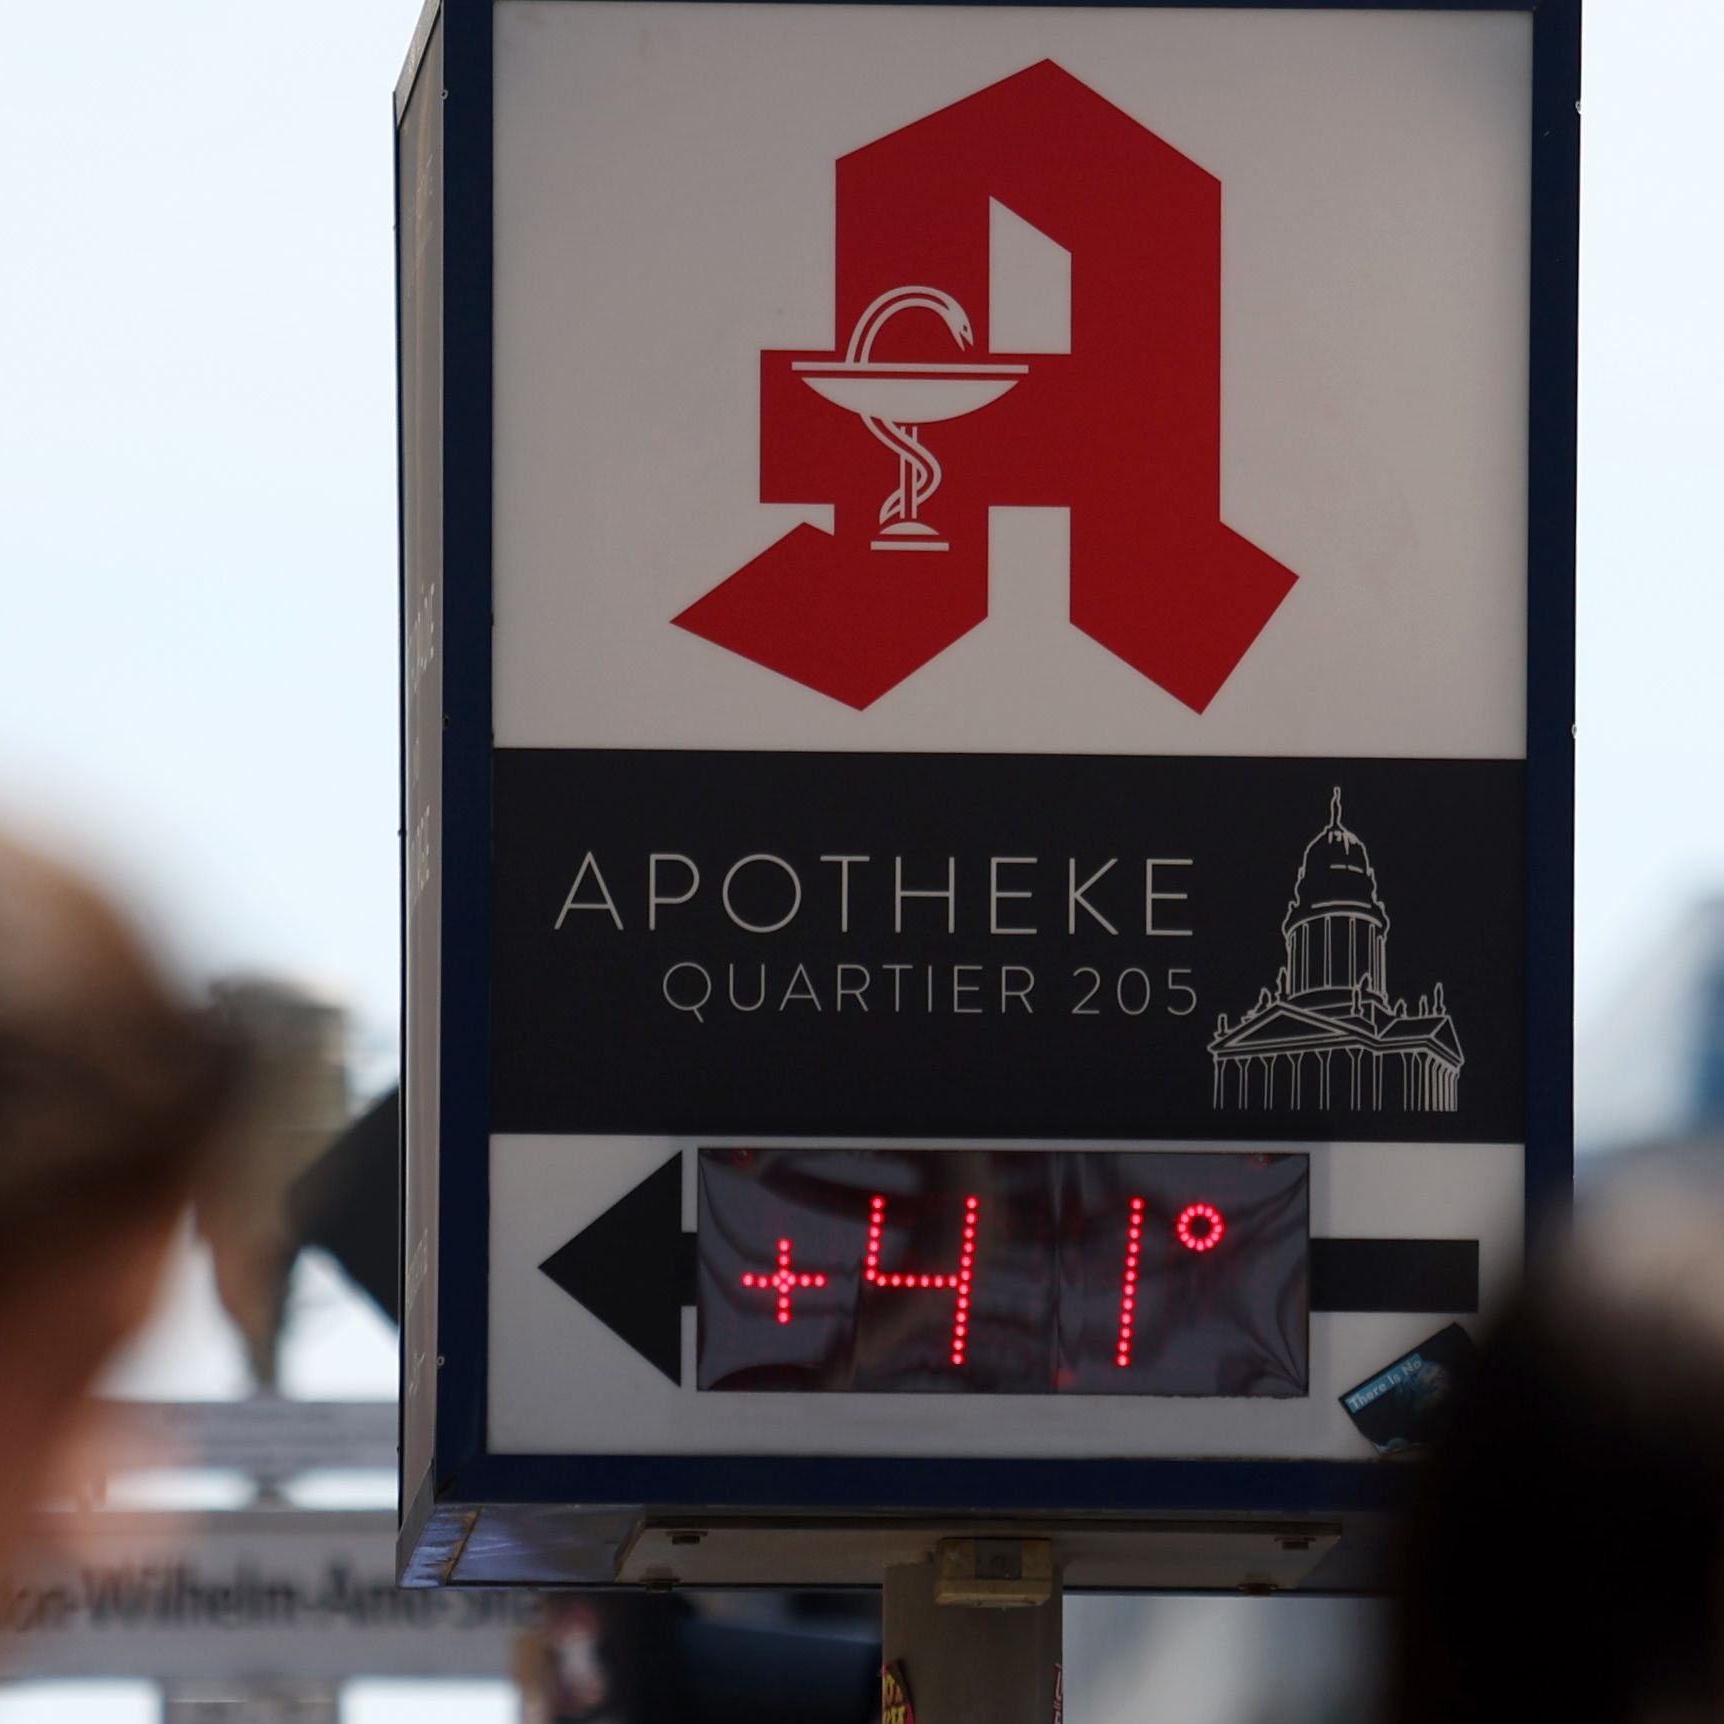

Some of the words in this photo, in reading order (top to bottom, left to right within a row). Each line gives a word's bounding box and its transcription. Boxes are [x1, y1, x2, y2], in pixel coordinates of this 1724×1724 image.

[553, 851, 1194, 937] APOTHEKE
[662, 961, 1037, 1022] QUARTIER
[1073, 966, 1197, 1016] 205
[1349, 1383, 1386, 1409] There
[1388, 1374, 1402, 1386] Is
[1402, 1359, 1423, 1377] No
